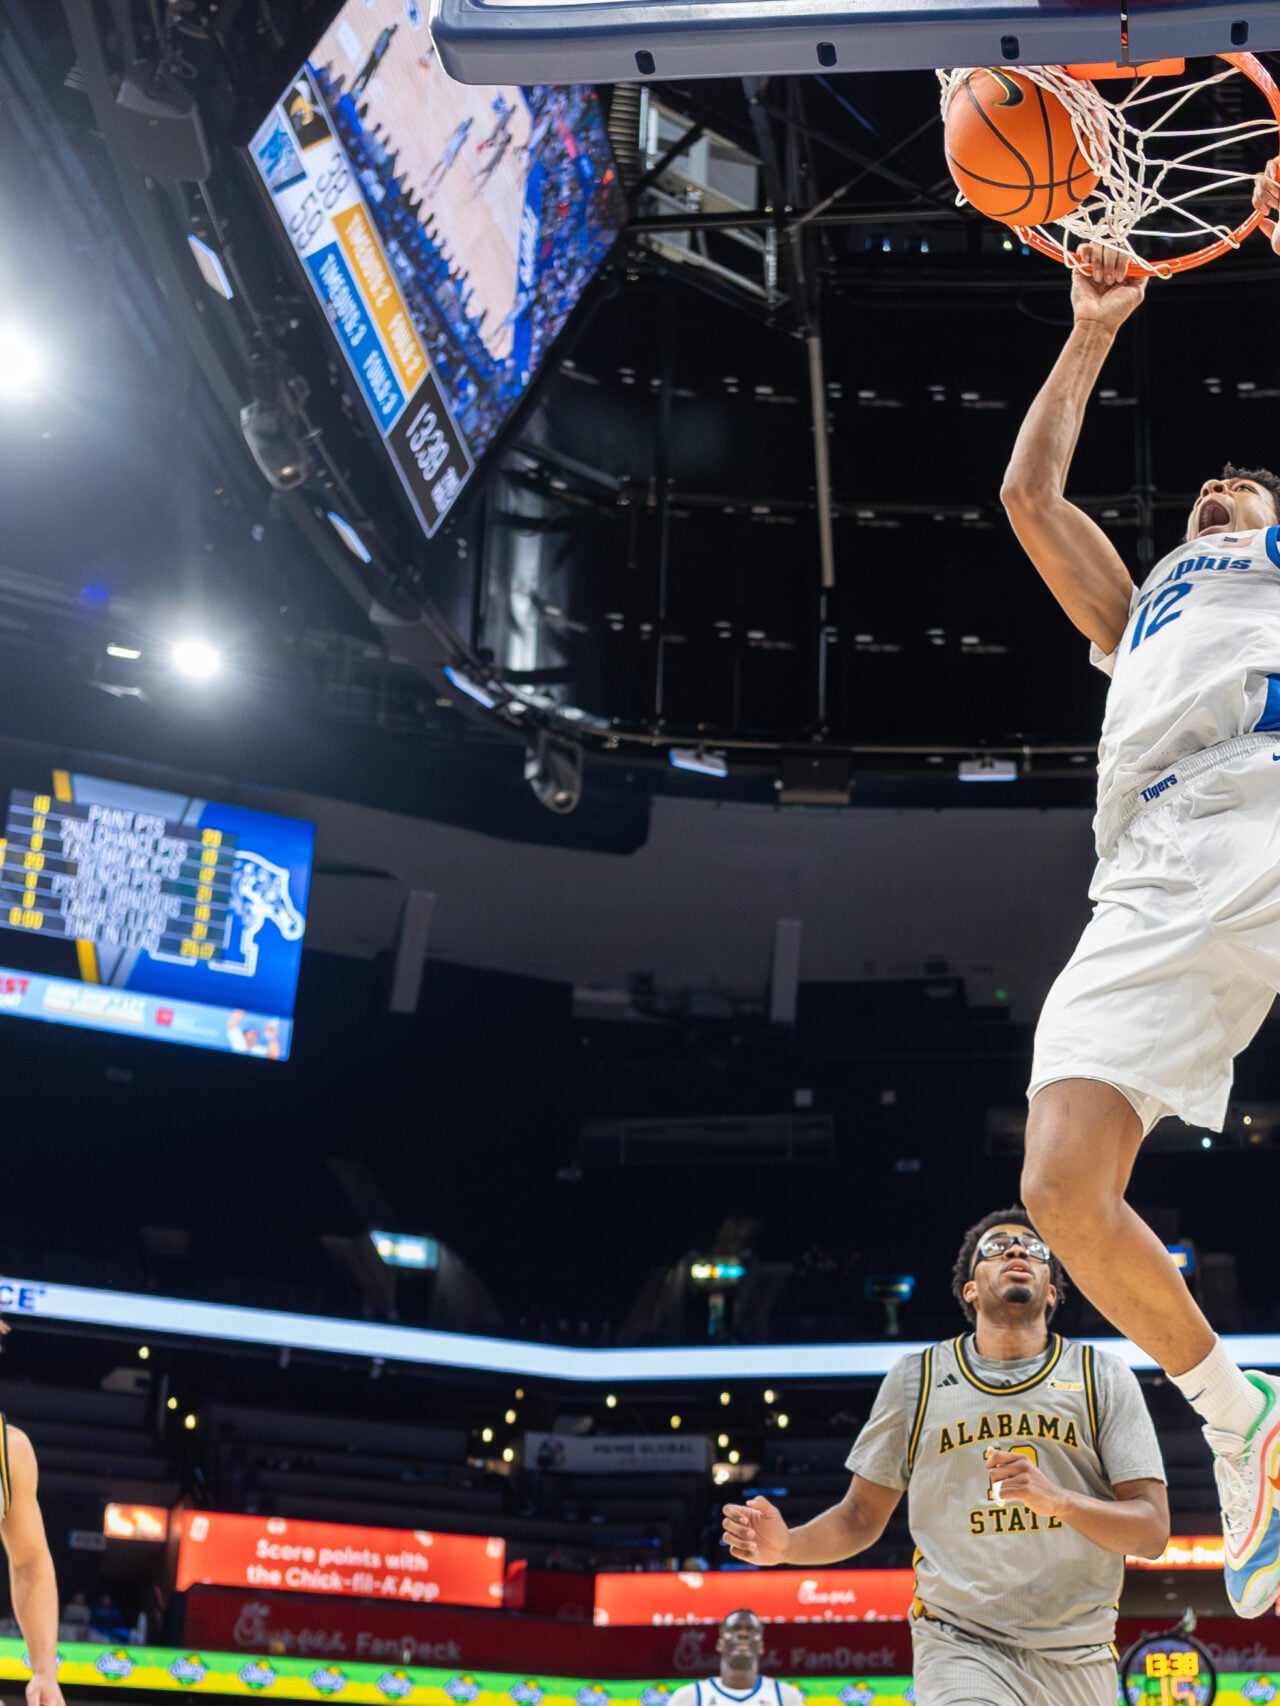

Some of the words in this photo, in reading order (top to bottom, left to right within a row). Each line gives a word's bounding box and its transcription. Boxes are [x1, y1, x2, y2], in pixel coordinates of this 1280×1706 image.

[316, 152, 349, 209] 38
[289, 192, 325, 250] 59
[1129, 582, 1194, 655] 12
[1140, 774, 1178, 803] Tigers
[939, 1411, 1079, 1455] ALABAMA
[255, 1538, 317, 1563] Score
[318, 1546, 382, 1570] points
[385, 1551, 429, 1572] with
[246, 1564, 282, 1586] the
[399, 1576, 440, 1602] App
[356, 1631, 461, 1662] FanDeck
[789, 1648, 896, 1670] FanDeck
